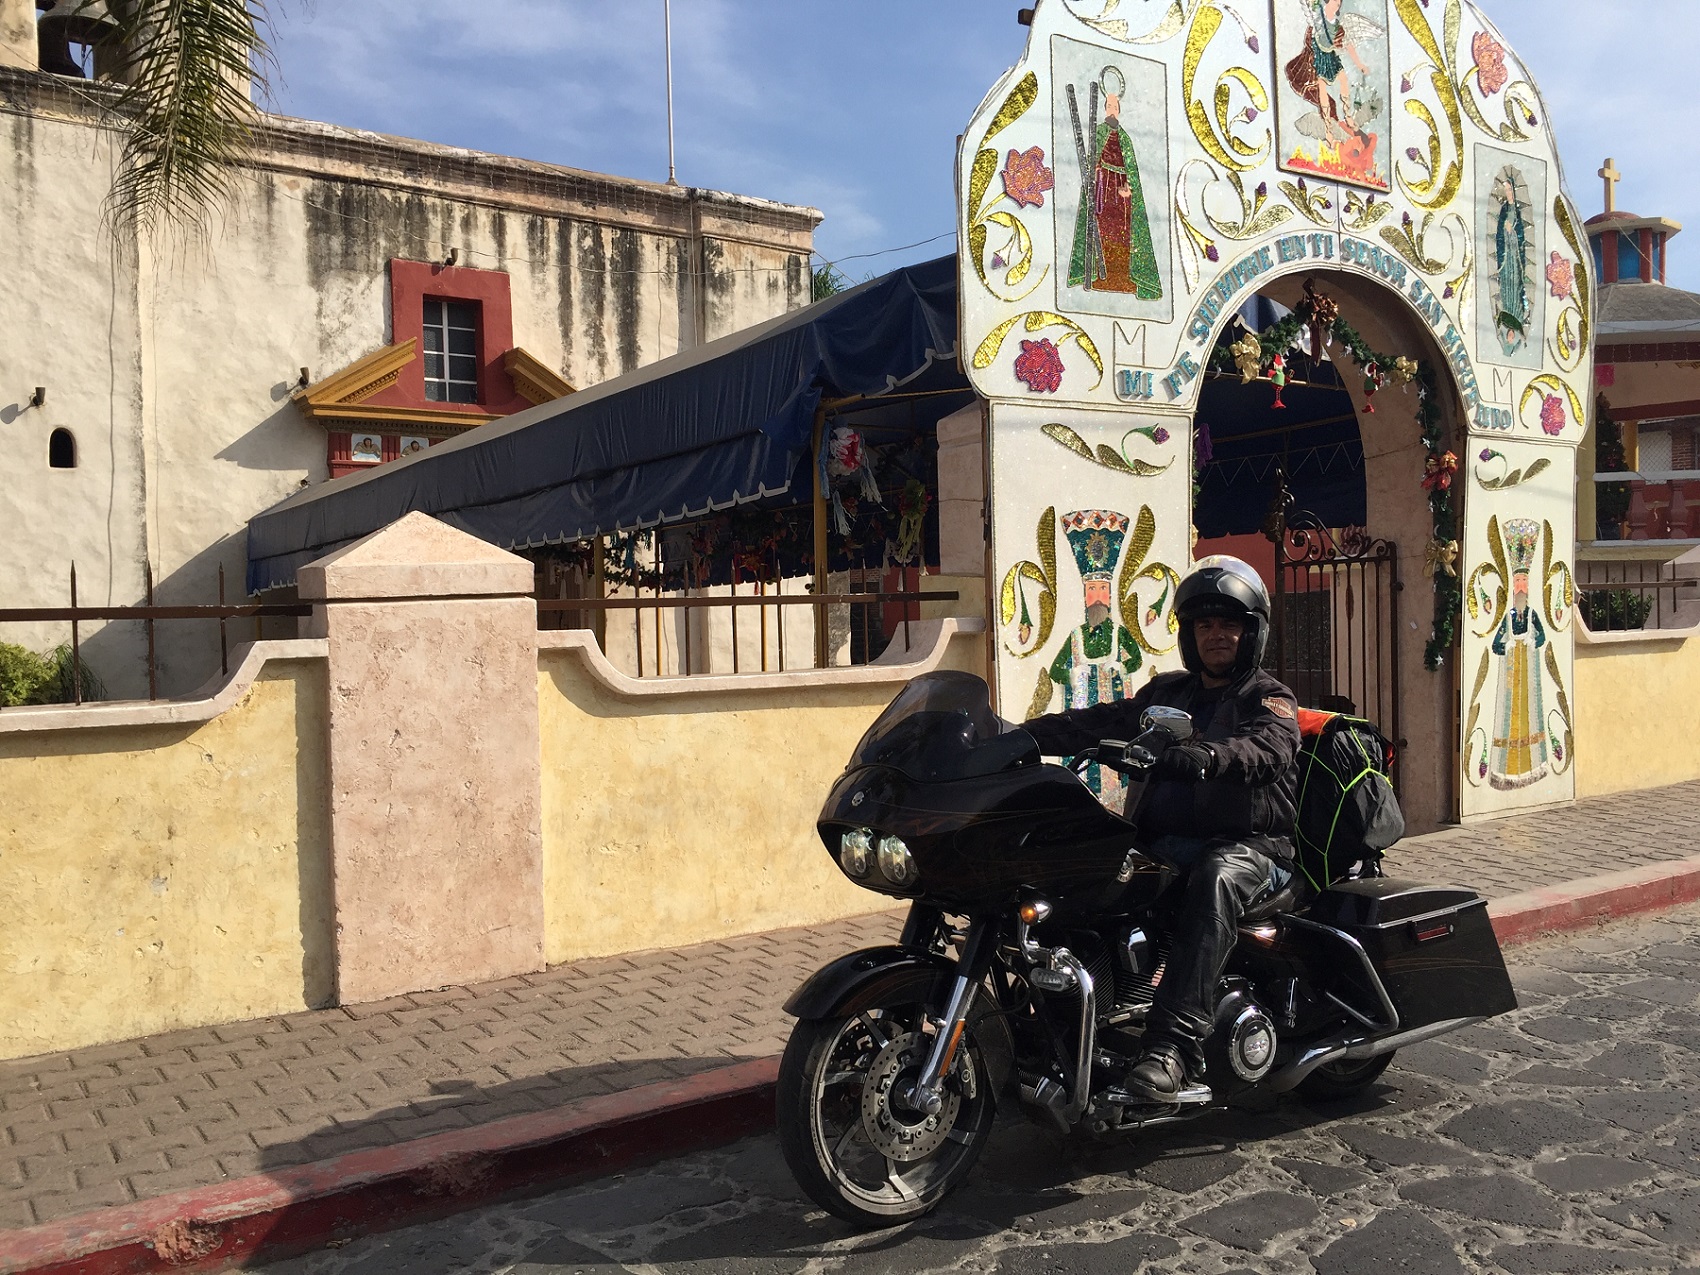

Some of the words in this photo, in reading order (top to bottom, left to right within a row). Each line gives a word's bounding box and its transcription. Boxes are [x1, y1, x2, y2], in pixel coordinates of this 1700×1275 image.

[1116, 370, 1154, 400] MI
[1160, 351, 1200, 402] FE
[1187, 246, 1274, 345] SIEMPRE
[1408, 280, 1445, 327] SAN
